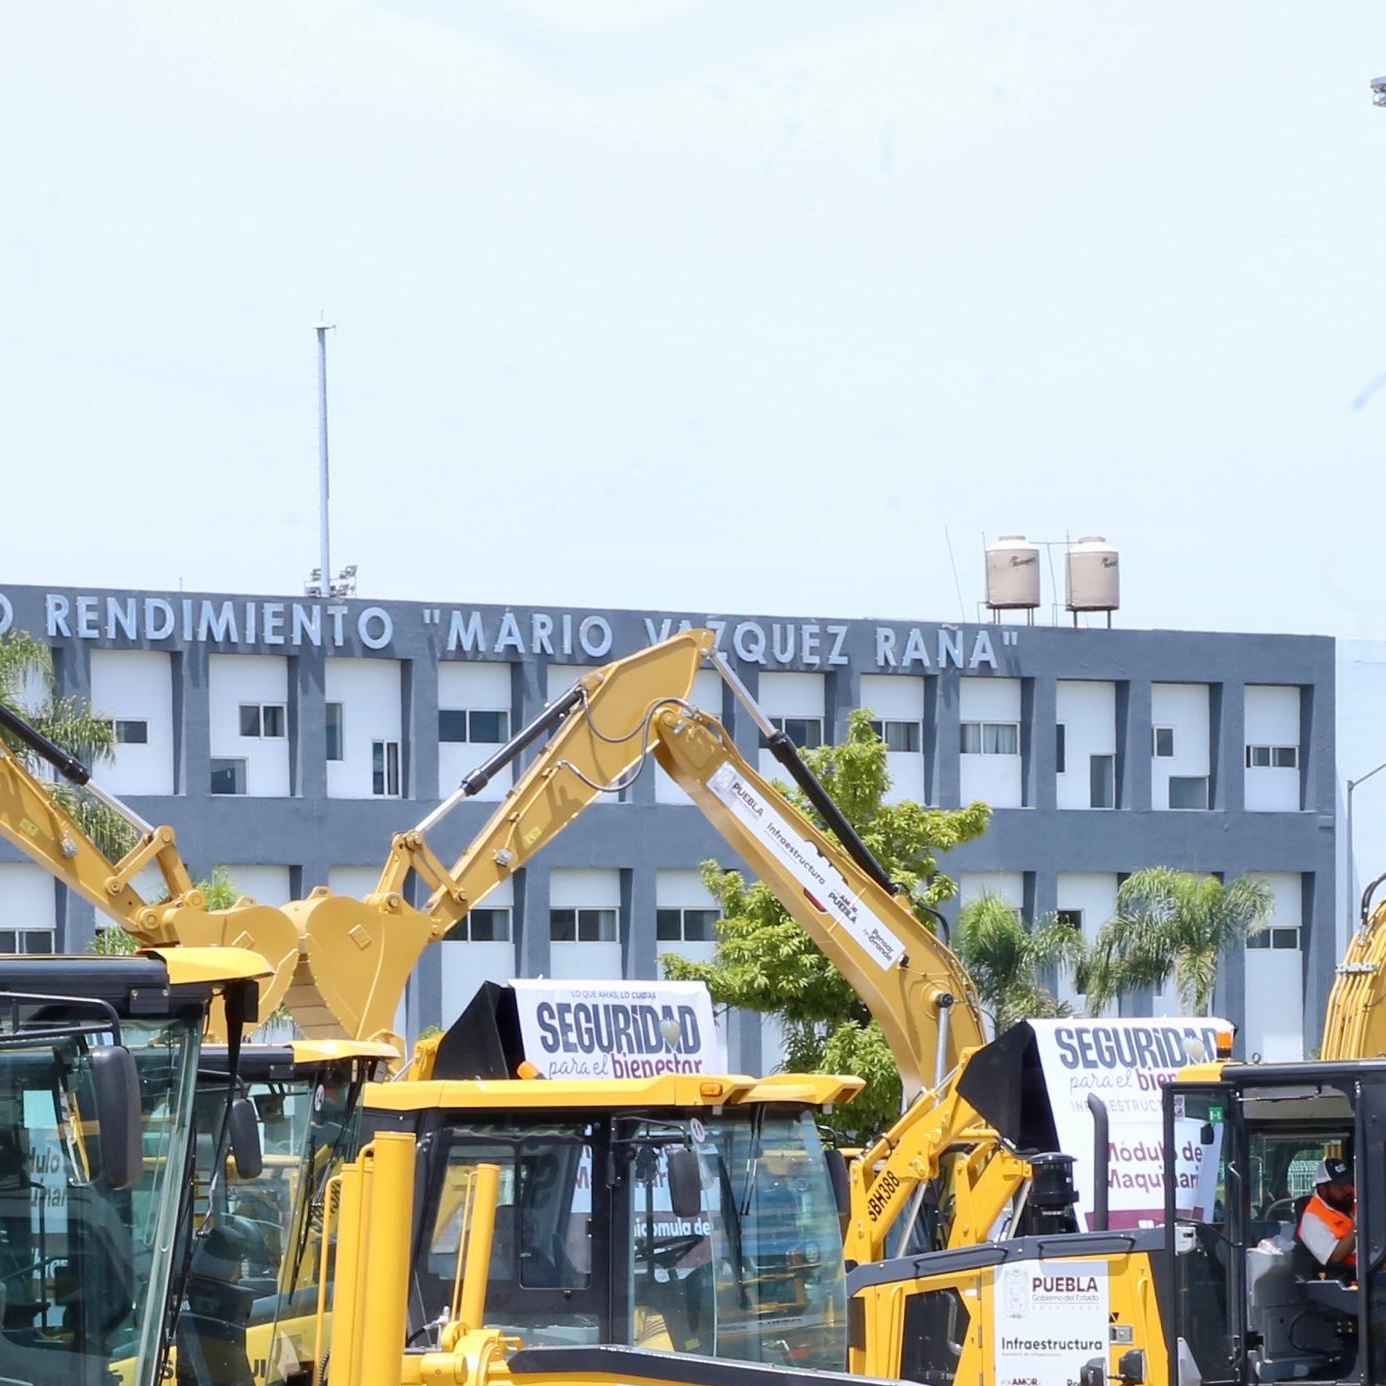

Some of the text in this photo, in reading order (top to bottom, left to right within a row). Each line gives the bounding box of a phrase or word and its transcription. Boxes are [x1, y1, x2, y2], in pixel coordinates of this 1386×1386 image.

[45, 594, 394, 650] RENDIMIENTO
[423, 607, 613, 657] "MARIO
[644, 617, 848, 666] VZQUEZ
[732, 782, 764, 817] PUEBLA
[766, 822, 826, 886] Infraestructura
[536, 1002, 701, 1054] SEGURIDAD
[549, 1056, 591, 1080] para
[593, 1053, 609, 1075] el
[1069, 1073, 1114, 1094] para
[1117, 1068, 1133, 1088] el
[1183, 1141, 1202, 1162] de
[694, 1217, 711, 1236] de
[1032, 1277, 1098, 1292] PUEBLA
[1002, 1337, 1103, 1351] Infraestructura
